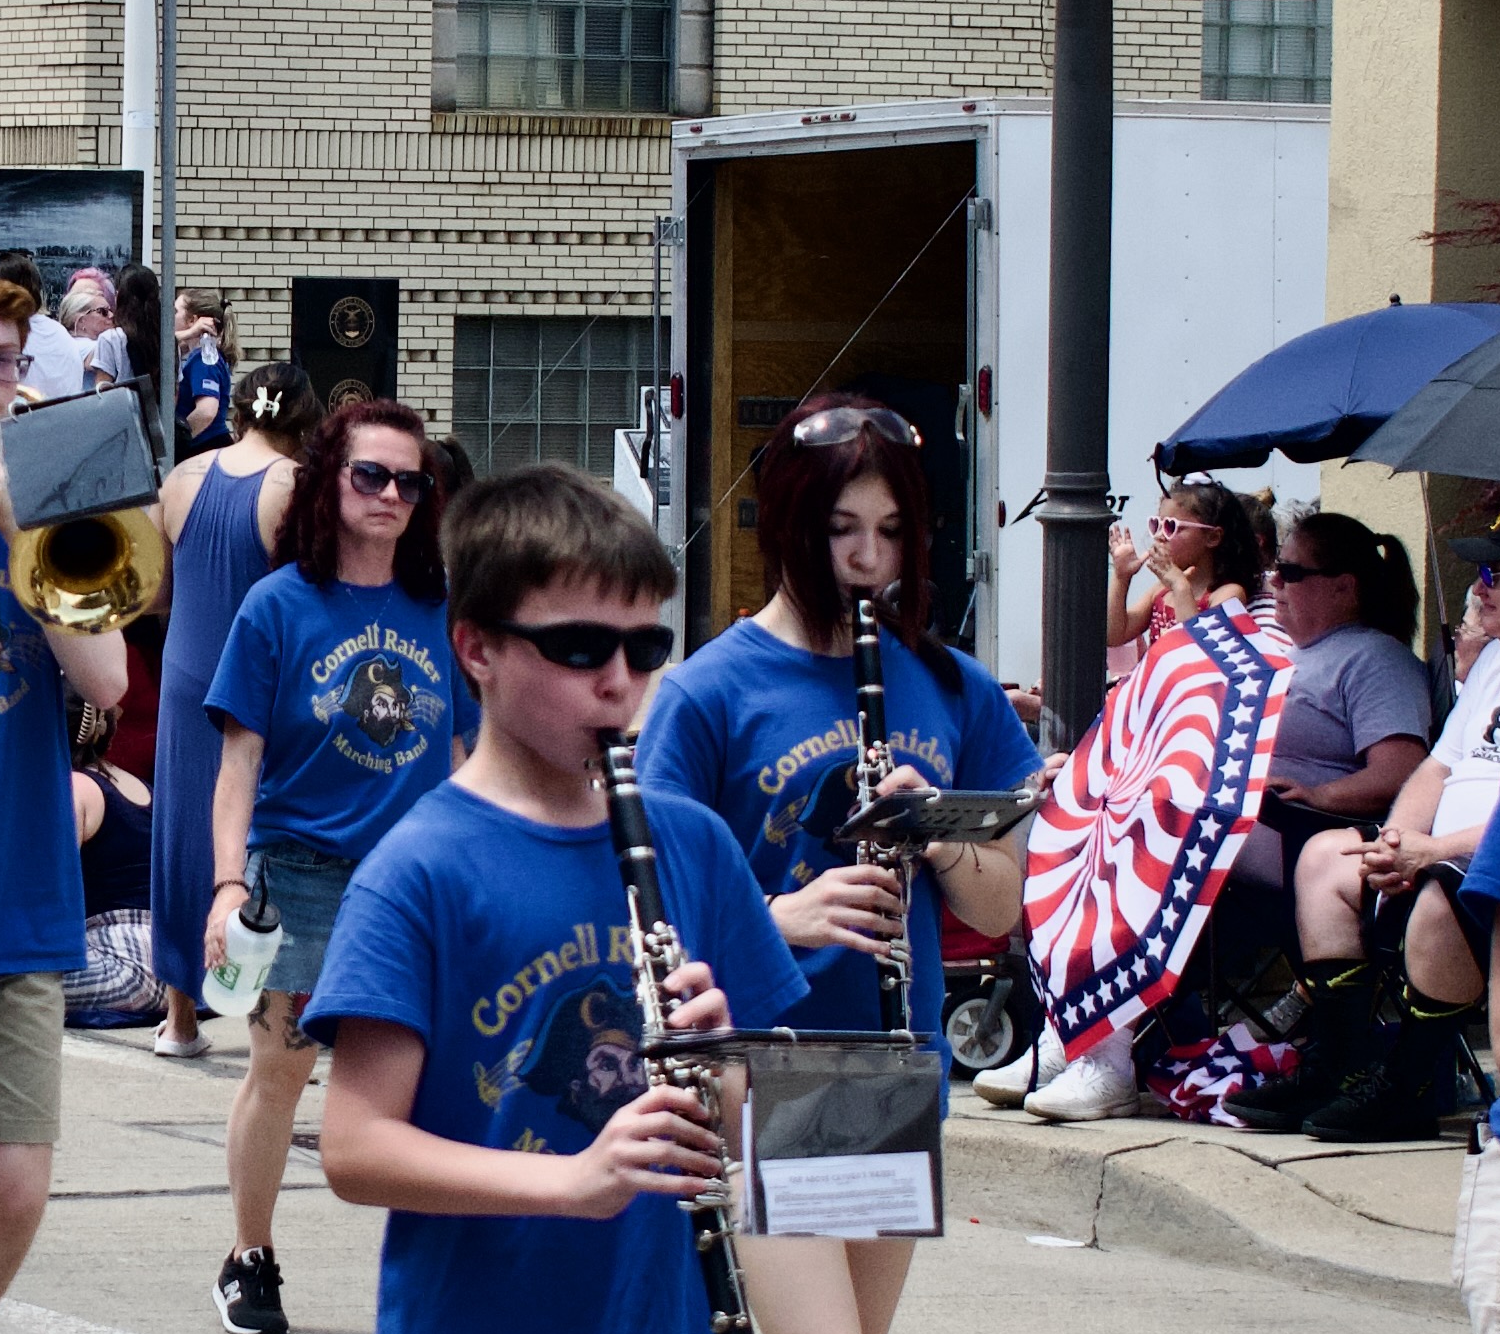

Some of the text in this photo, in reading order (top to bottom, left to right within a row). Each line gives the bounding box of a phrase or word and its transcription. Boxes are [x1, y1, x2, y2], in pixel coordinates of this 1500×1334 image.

[311, 619, 441, 683] Cornell Raider
[332, 732, 428, 774] Marching Band
[758, 720, 860, 795] Cornell
[472, 923, 600, 1037] Cornell
